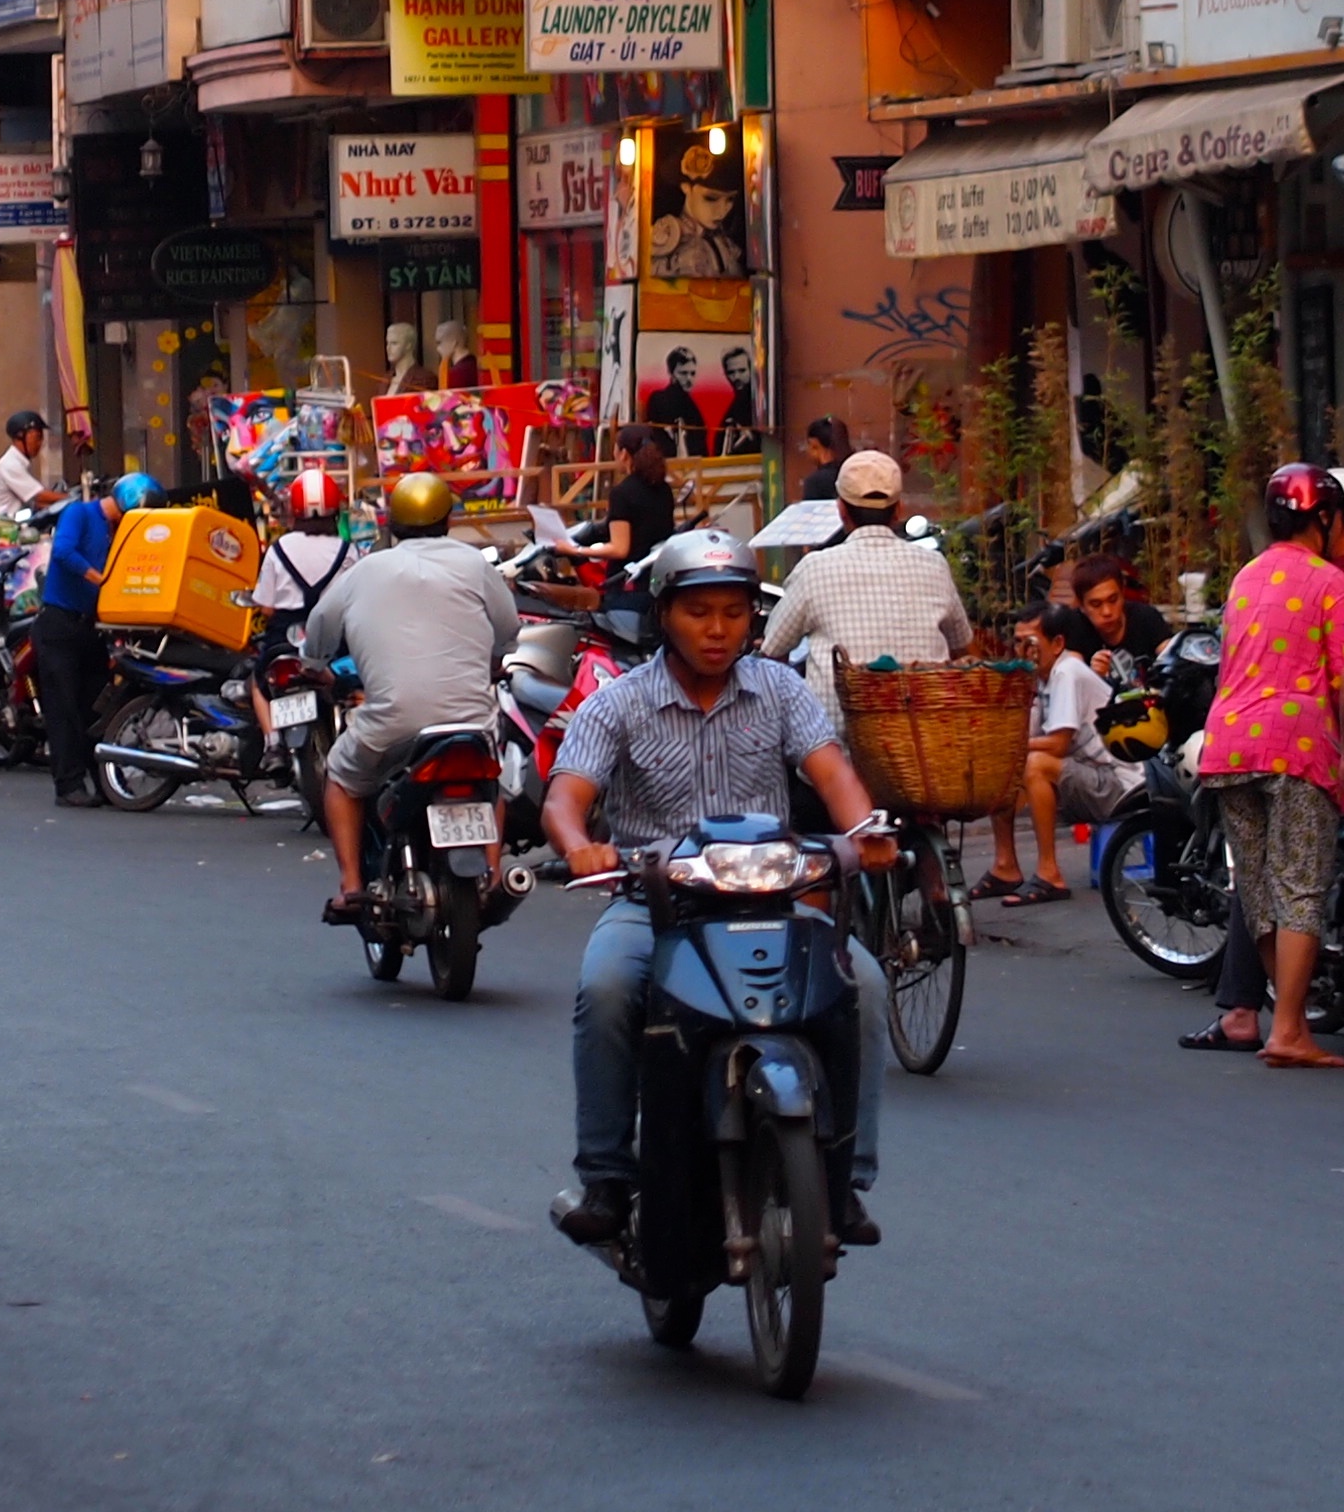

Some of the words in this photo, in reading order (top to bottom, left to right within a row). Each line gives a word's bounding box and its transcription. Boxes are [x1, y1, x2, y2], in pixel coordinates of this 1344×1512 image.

[541, 5, 619, 34] LAUNDRY
[625, 4, 712, 34] DRYCLEAN
[424, 26, 523, 48] GALLERY
[348, 140, 379, 157] NHÀ
[384, 142, 416, 156] MAY
[1109, 148, 1168, 182] Crepe
[1176, 135, 1197, 166] &
[1199, 124, 1265, 164] Coffee
[339, 170, 416, 203] Nhựt
[169, 245, 261, 261] VIETNAMESE
[166, 269, 196, 284] RICE
[201, 268, 266, 285] PAINTING
